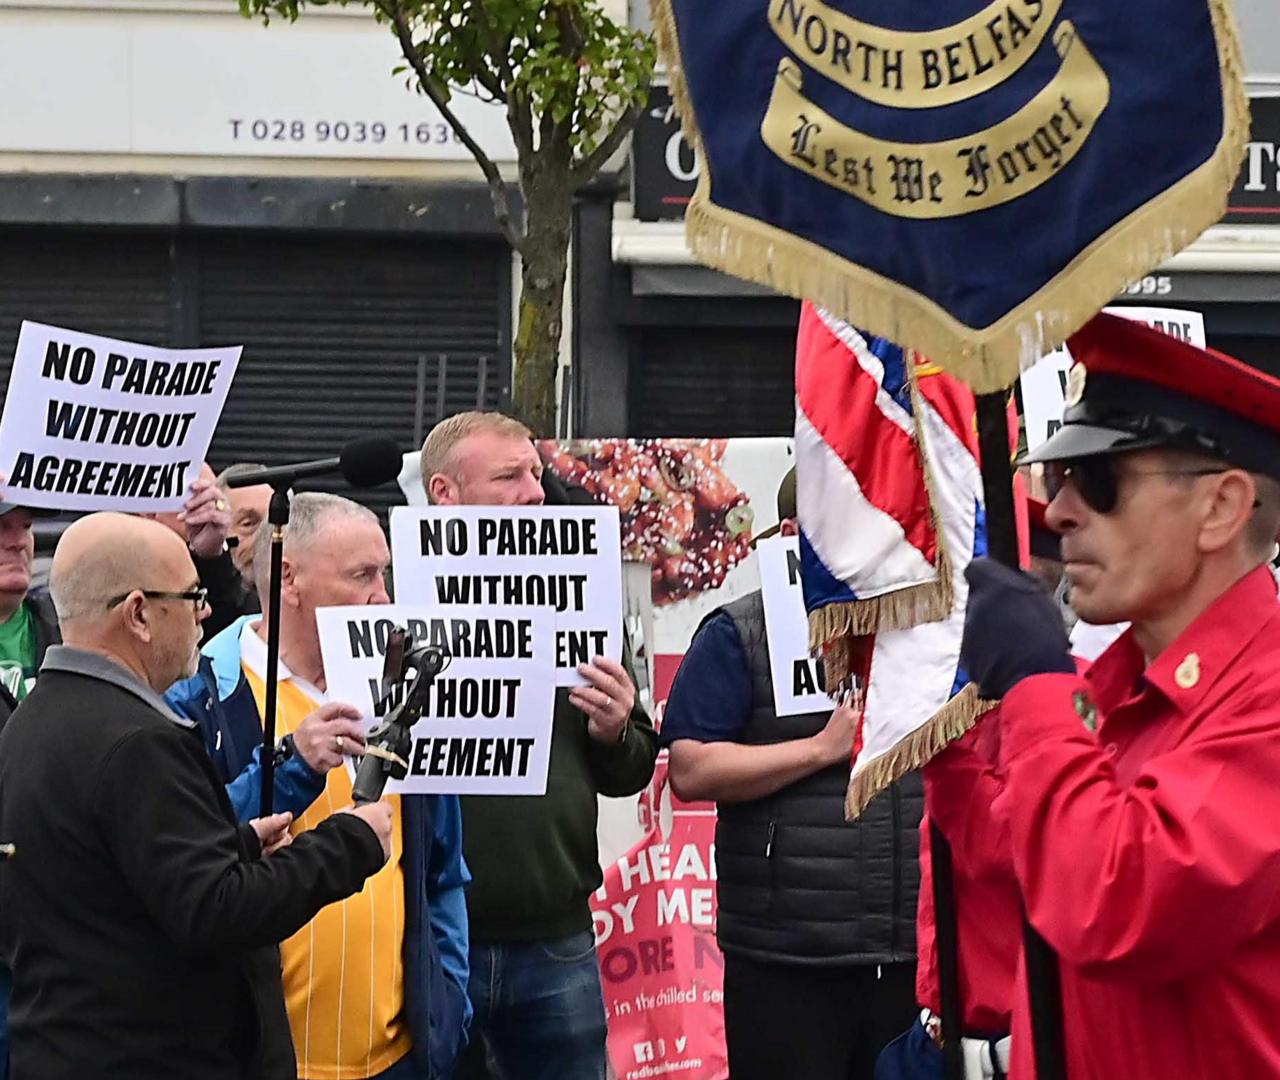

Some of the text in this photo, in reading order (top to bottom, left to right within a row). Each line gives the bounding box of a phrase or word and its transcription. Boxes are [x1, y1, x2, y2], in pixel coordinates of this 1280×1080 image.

[778, 0, 1044, 91] NORTH BELFAS
[229, 120, 242, 139] T
[252, 120, 305, 141] 028
[316, 121, 386, 142] 9039
[790, 114, 877, 195] Lest
[888, 154, 943, 203] We
[957, 96, 1084, 198] Forget
[42, 340, 222, 397] NO PARADE
[45, 399, 197, 449] WITHOUT
[8, 451, 192, 499] AGREEMENT
[420, 518, 598, 556] NO PARADE
[435, 574, 588, 612] WITHOUT
[407, 619, 533, 659] PARADE
[410, 738, 536, 777] EEMENT
[602, 935, 675, 984] ORE
